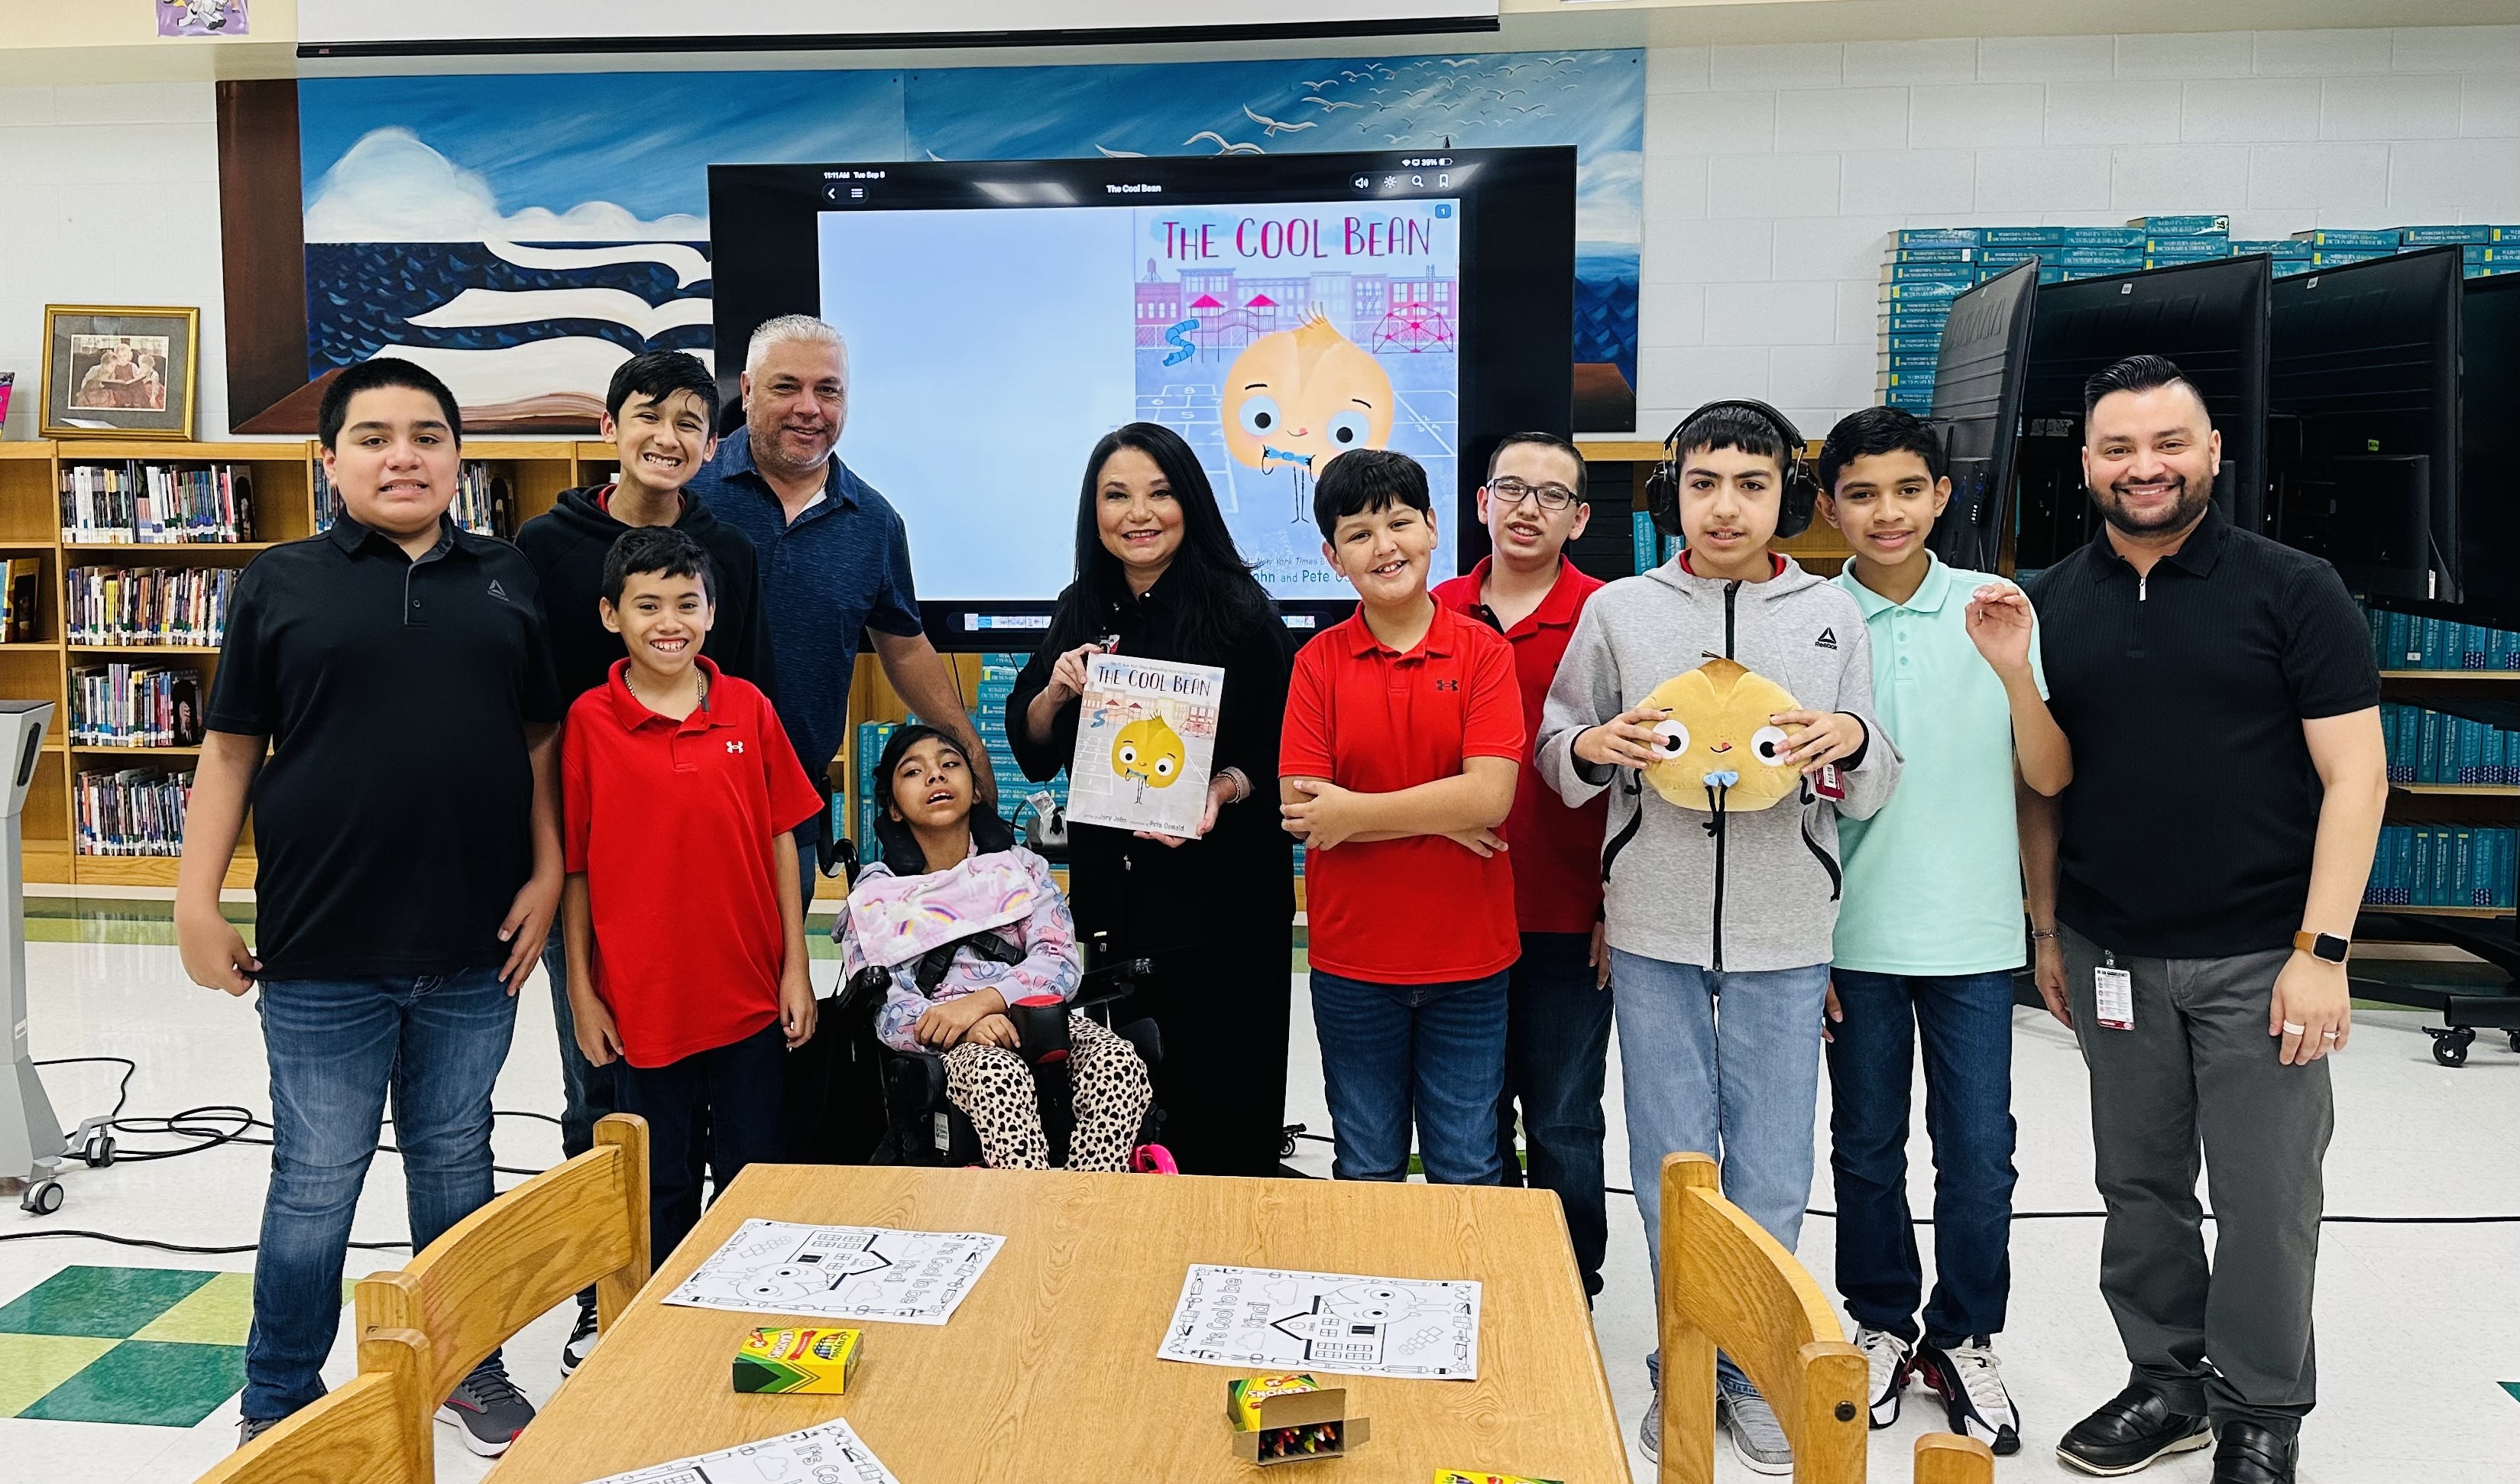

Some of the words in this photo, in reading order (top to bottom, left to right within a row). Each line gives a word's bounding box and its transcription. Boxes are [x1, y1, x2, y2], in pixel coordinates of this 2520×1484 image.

[1122, 184, 1140, 193] Cool
[1142, 183, 1161, 193] Bean
[1162, 222, 1219, 260] THE
[1236, 218, 1328, 258] COOL
[1343, 217, 1430, 257] BEAN
[1276, 556, 1293, 565] York
[1253, 570, 1275, 582] ohn
[1282, 572, 1297, 582] and
[1302, 570, 1330, 582] Pete
[1099, 666, 1121, 685] THE
[1129, 669, 1166, 691] COOL
[1173, 675, 1210, 697] BEAN
[920, 1256, 953, 1278] Cool
[912, 1278, 938, 1288] to
[1216, 1278, 1242, 1293] be
[900, 1290, 931, 1304] be
[1213, 1295, 1238, 1306] to
[1207, 1308, 1235, 1330] Cool
[767, 1330, 795, 1359] CRAYONS
[831, 1333, 852, 1358] Crayola
